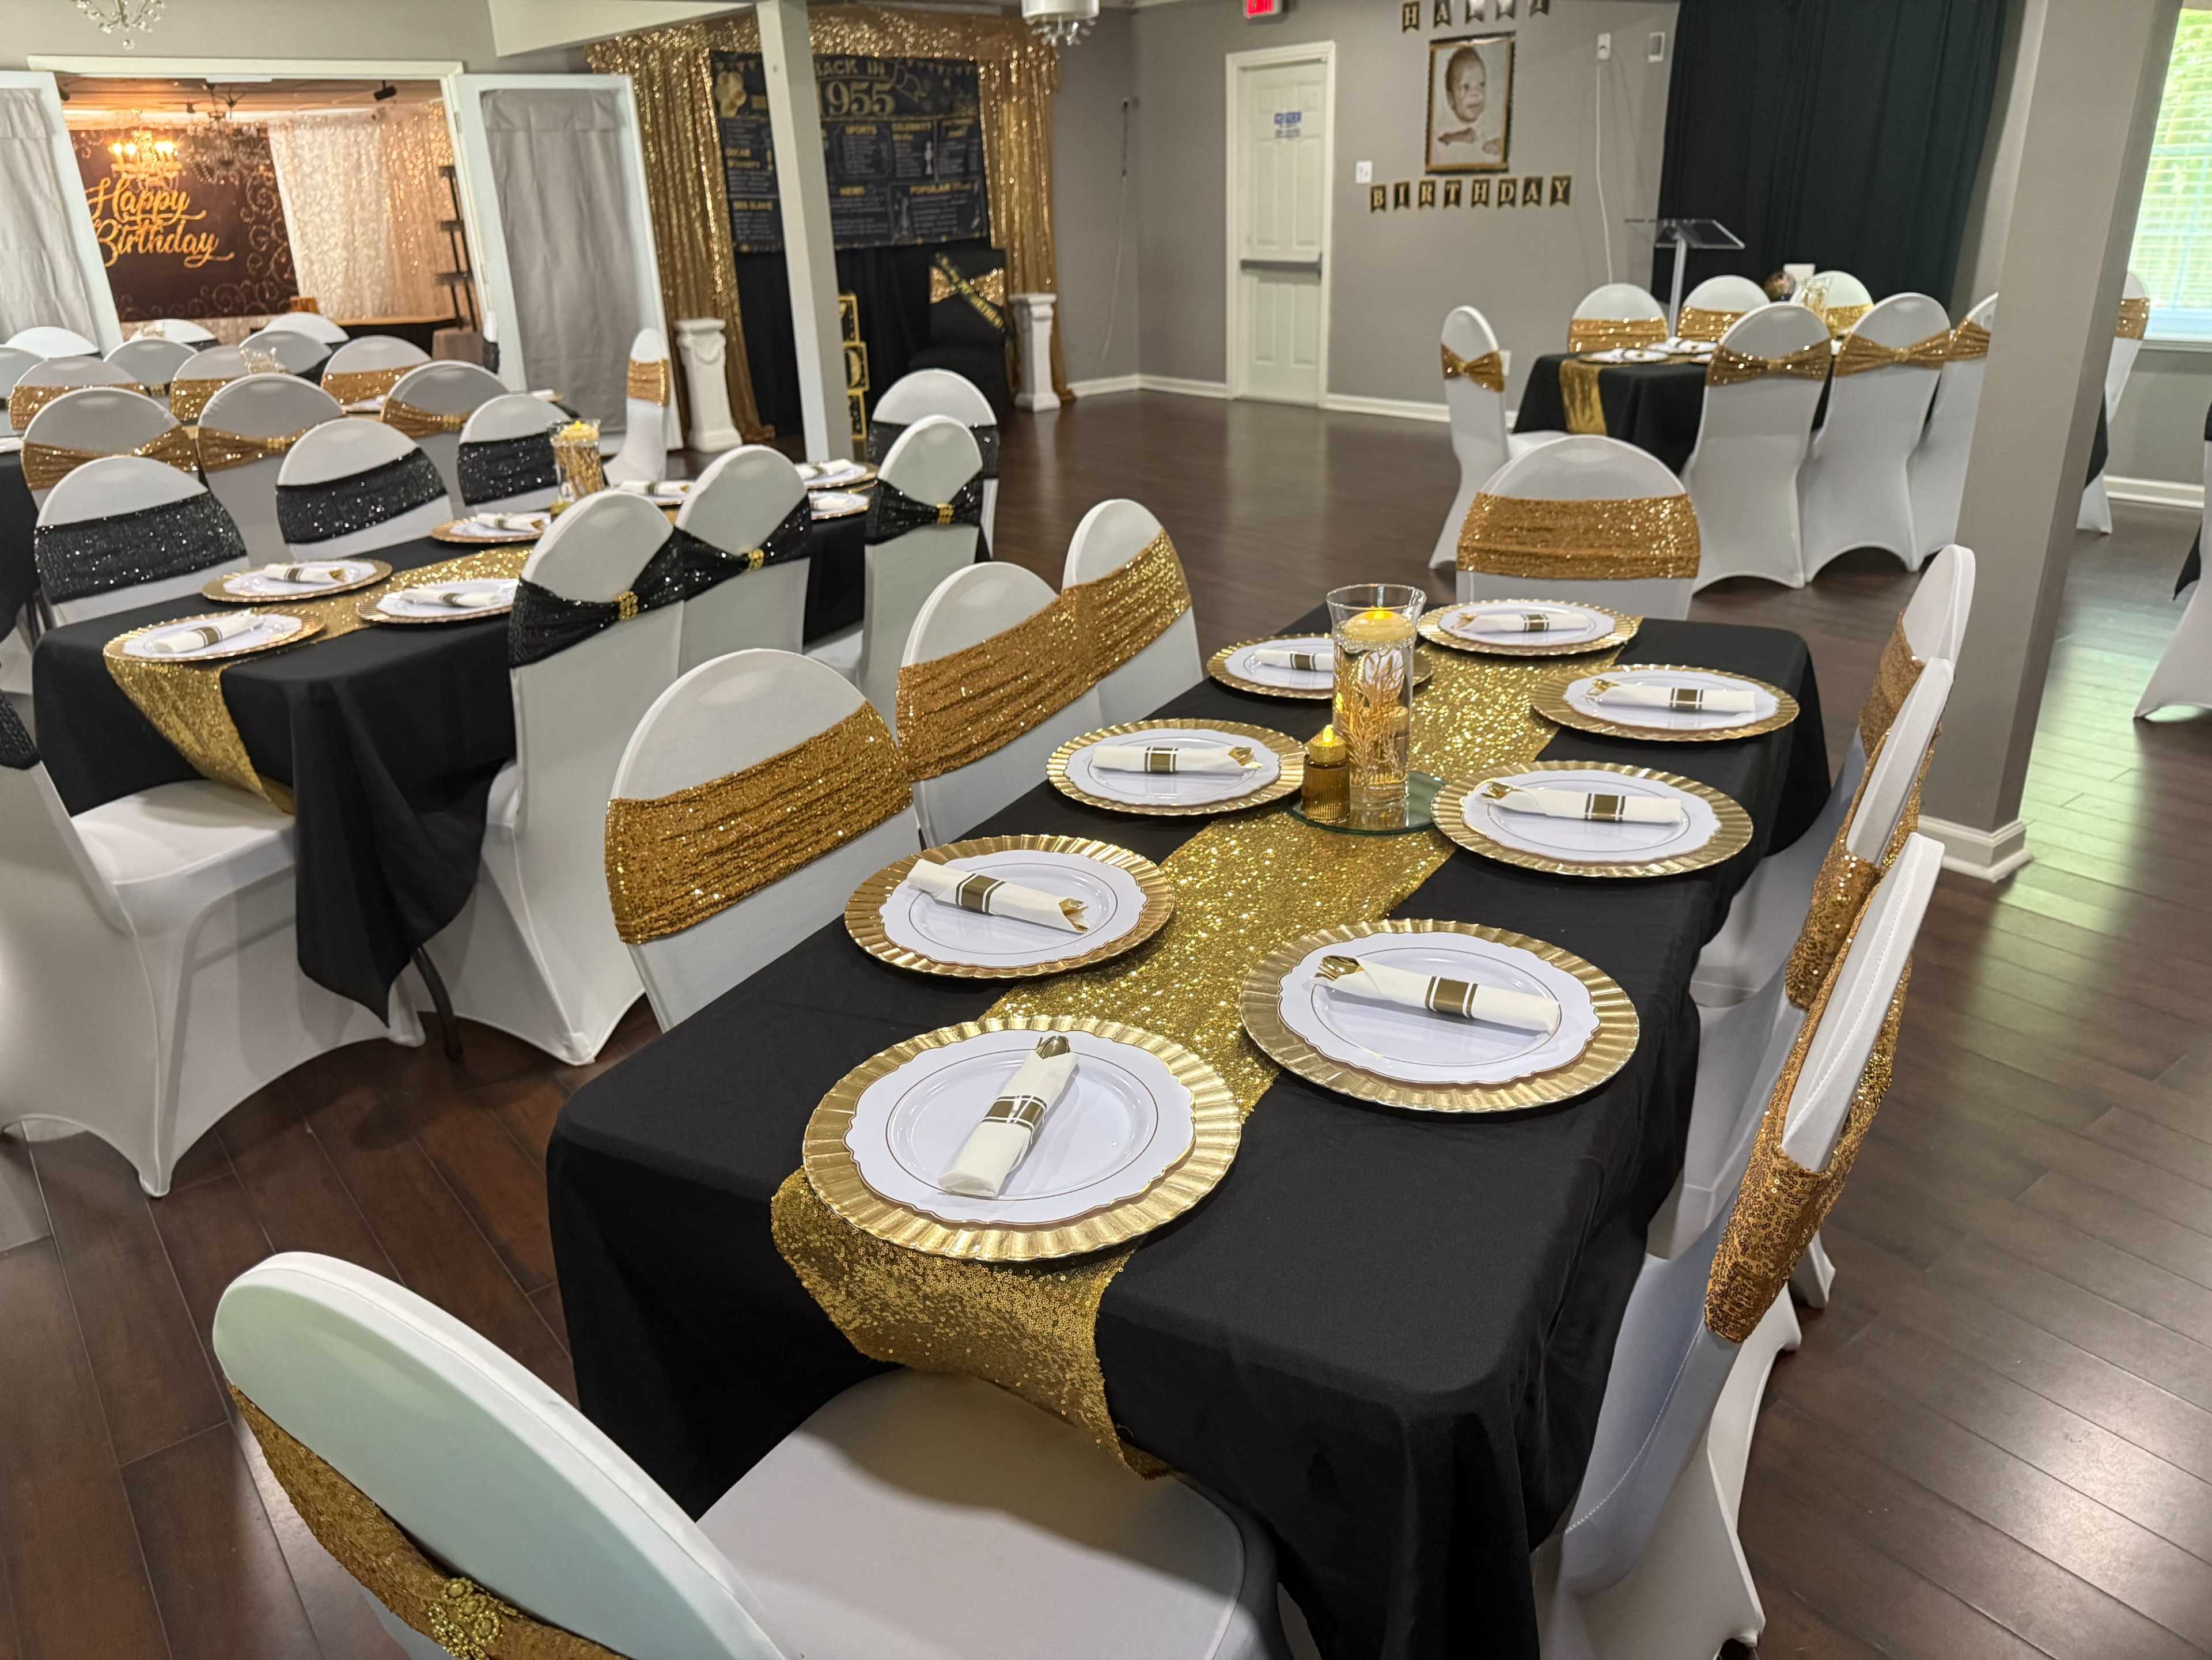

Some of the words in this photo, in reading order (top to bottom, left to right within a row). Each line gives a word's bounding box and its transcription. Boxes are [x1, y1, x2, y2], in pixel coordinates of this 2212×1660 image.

[84, 176, 207, 226] Happy
[1373, 180, 1569, 208] BIRTHDAY
[92, 218, 235, 269] Birthday
